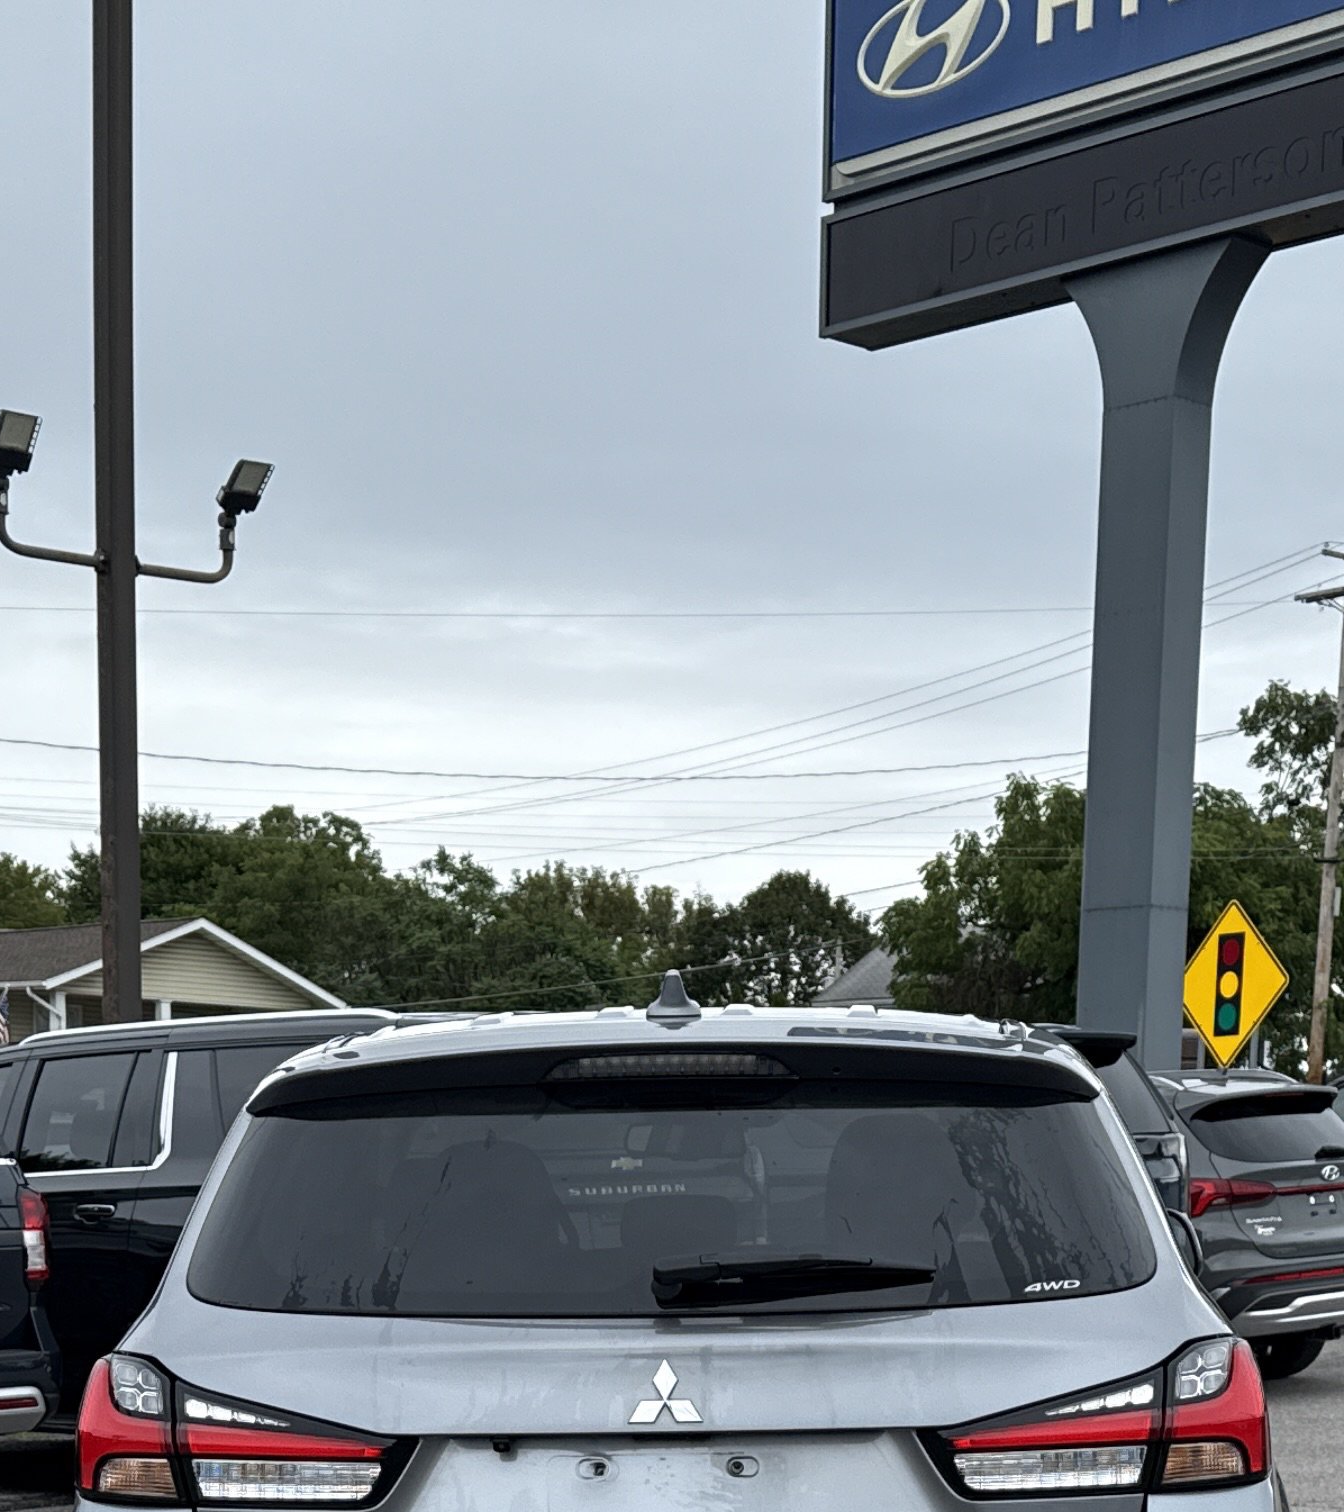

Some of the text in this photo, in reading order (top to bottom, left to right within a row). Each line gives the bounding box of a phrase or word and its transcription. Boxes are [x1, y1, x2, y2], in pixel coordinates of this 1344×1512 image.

[948, 201, 1067, 273] Dean
[568, 1184, 686, 1196] SUBURBAN
[1024, 1280, 1081, 1292] 4WD
